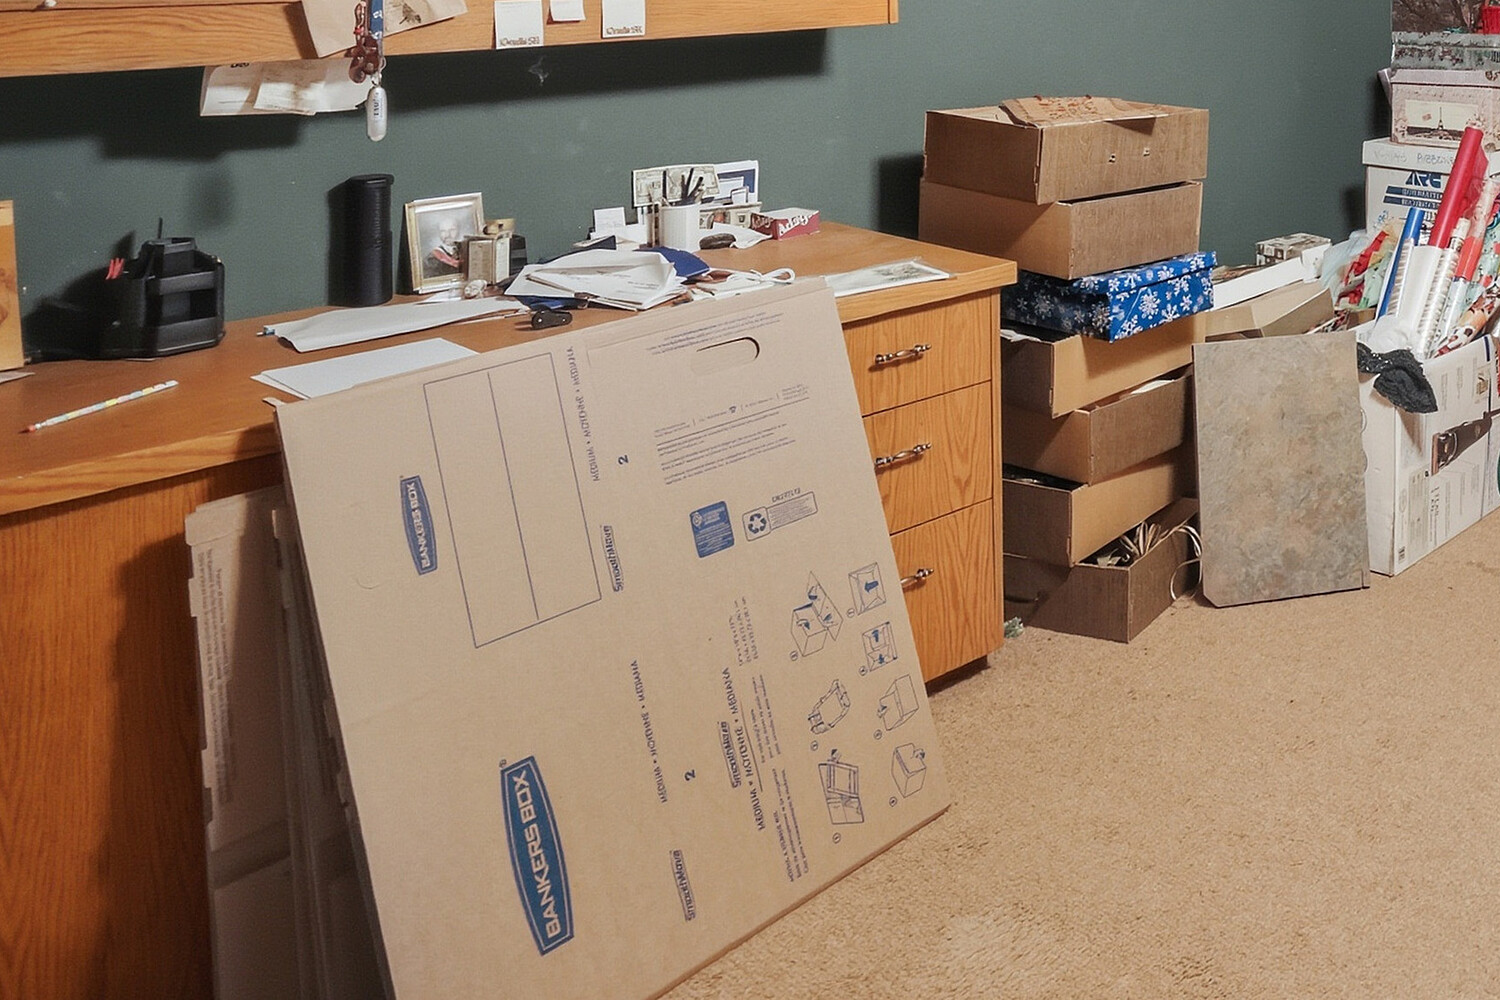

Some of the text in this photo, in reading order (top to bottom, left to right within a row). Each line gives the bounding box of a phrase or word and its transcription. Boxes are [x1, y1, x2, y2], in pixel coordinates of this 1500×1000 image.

[617, 454, 629, 466] 2
[406, 482, 431, 569] BANKERS BOX
[684, 769, 696, 782] 2
[512, 770, 562, 939] BANKERS BOX
